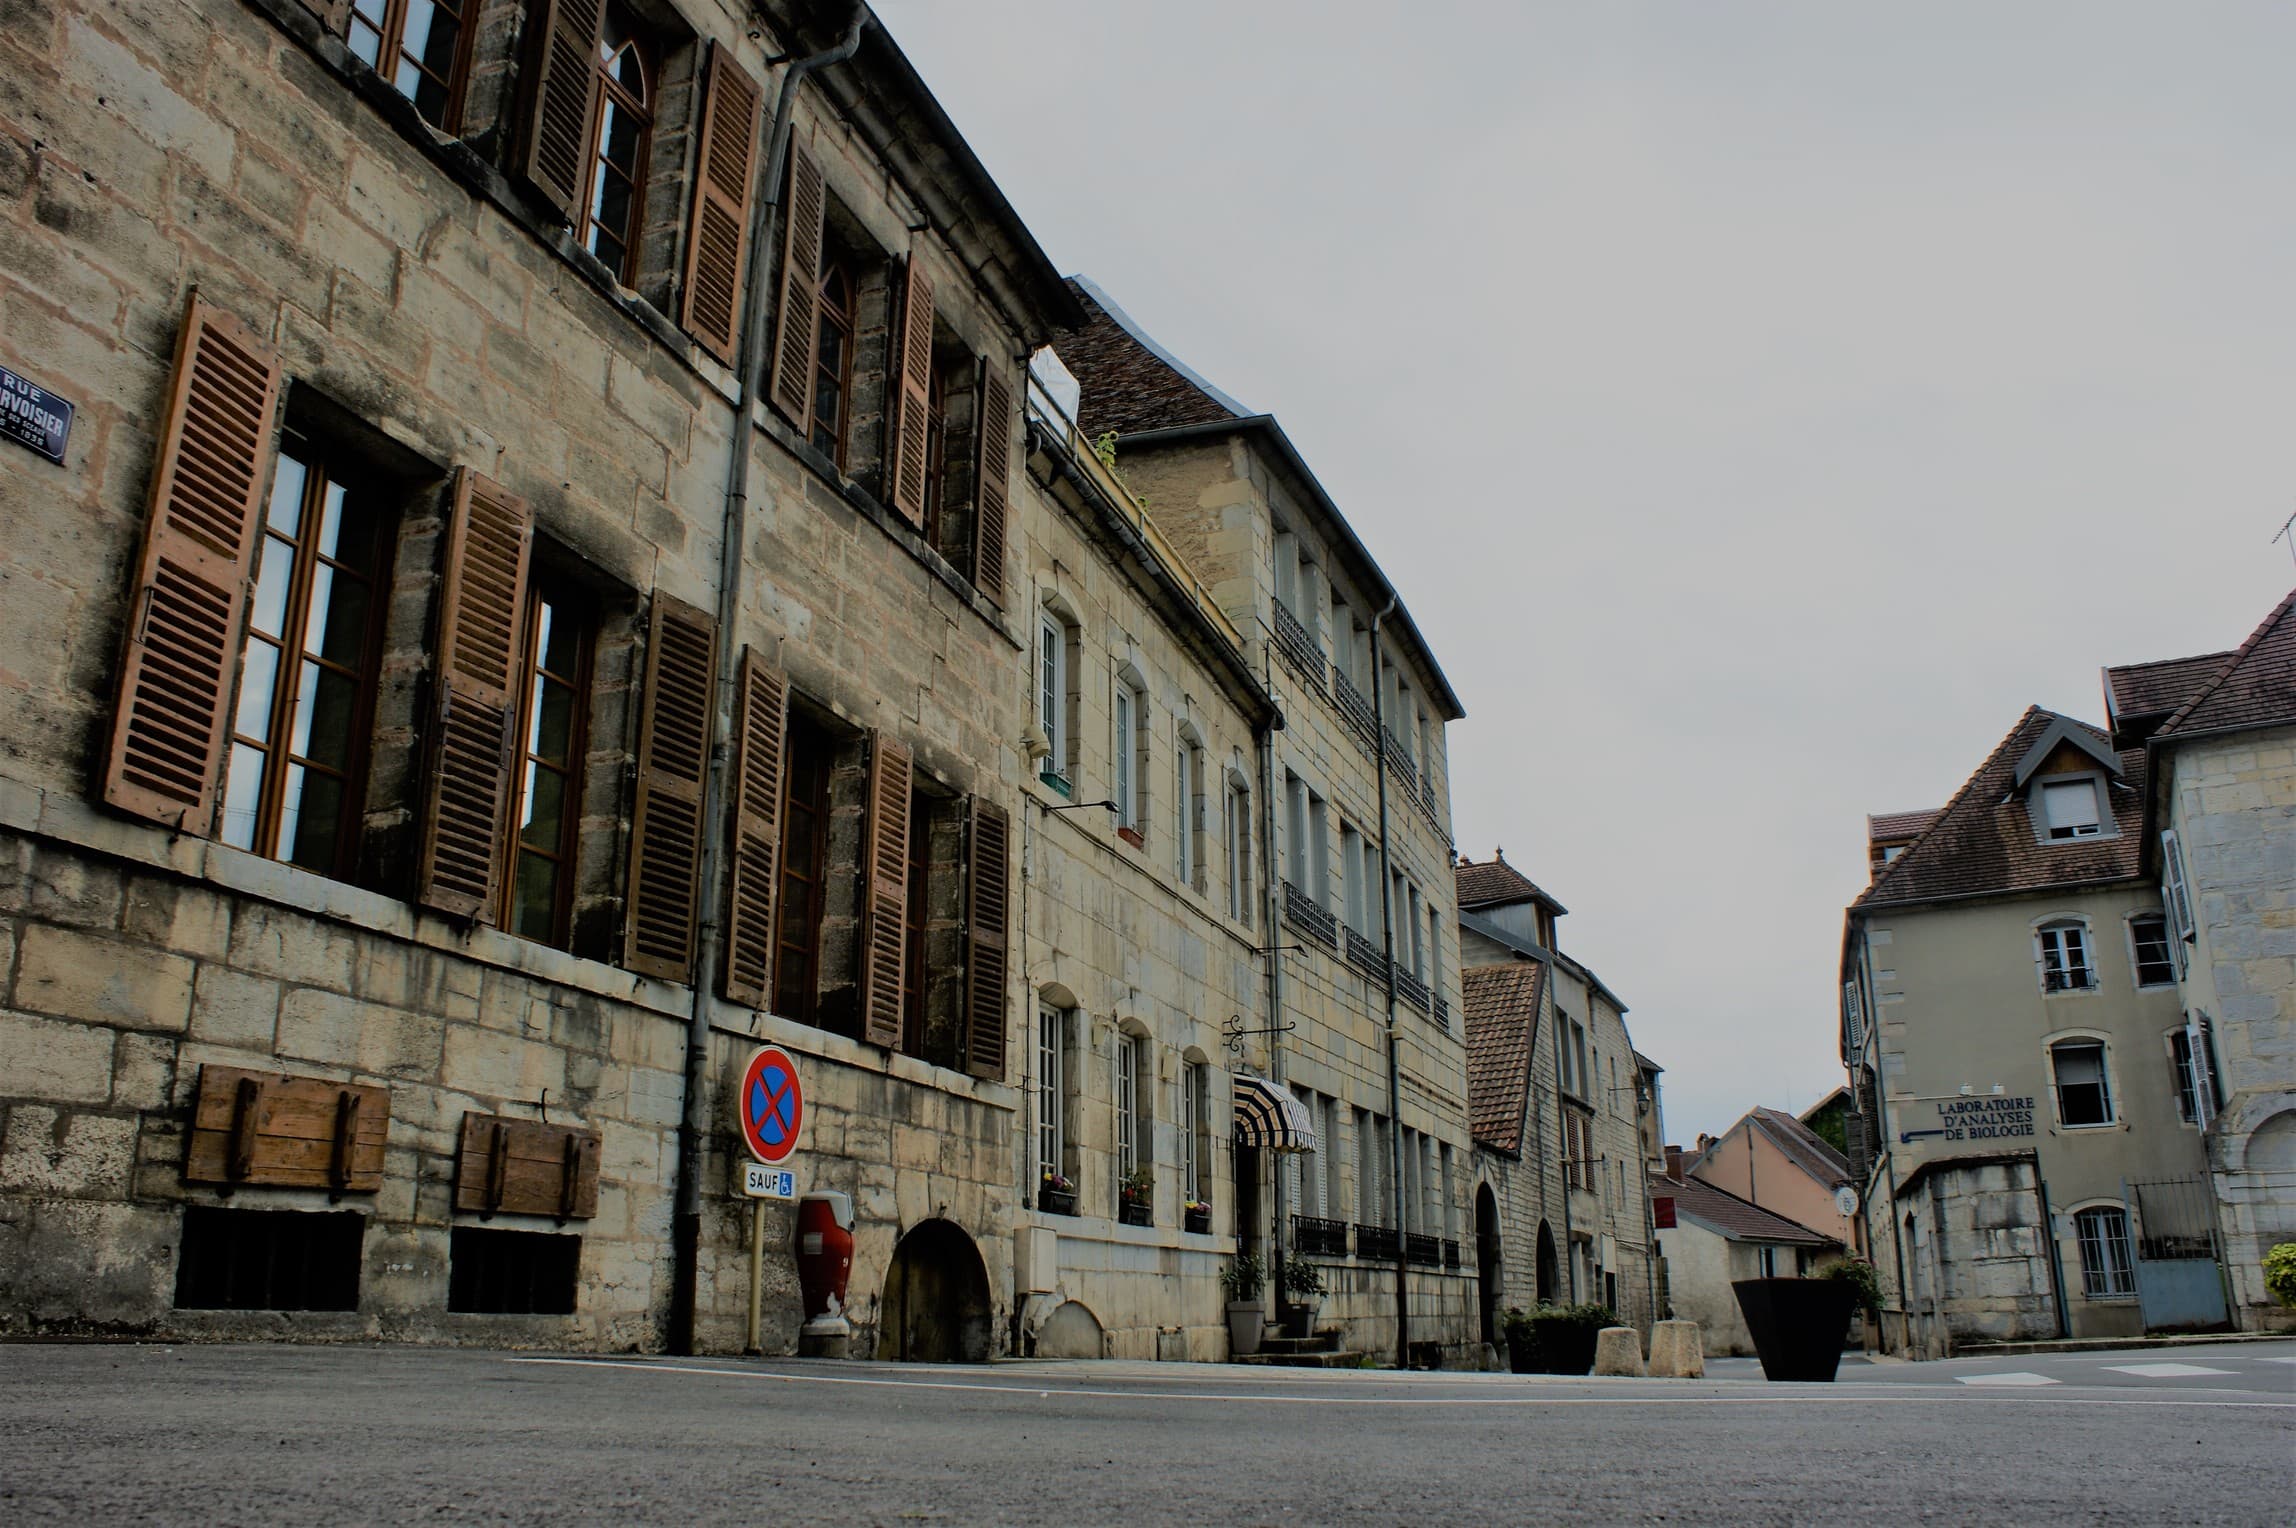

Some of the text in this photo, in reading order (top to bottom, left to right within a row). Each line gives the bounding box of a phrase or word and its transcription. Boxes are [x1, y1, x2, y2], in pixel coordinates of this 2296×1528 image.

[4, 373, 41, 402] RUE
[1937, 1097, 2035, 1115] LABORATOIRE
[1943, 1111, 2033, 1128] D'ANALYSES
[1944, 1124, 2035, 1141] DE BIOLOGIE
[750, 1172, 778, 1190] SAUF
